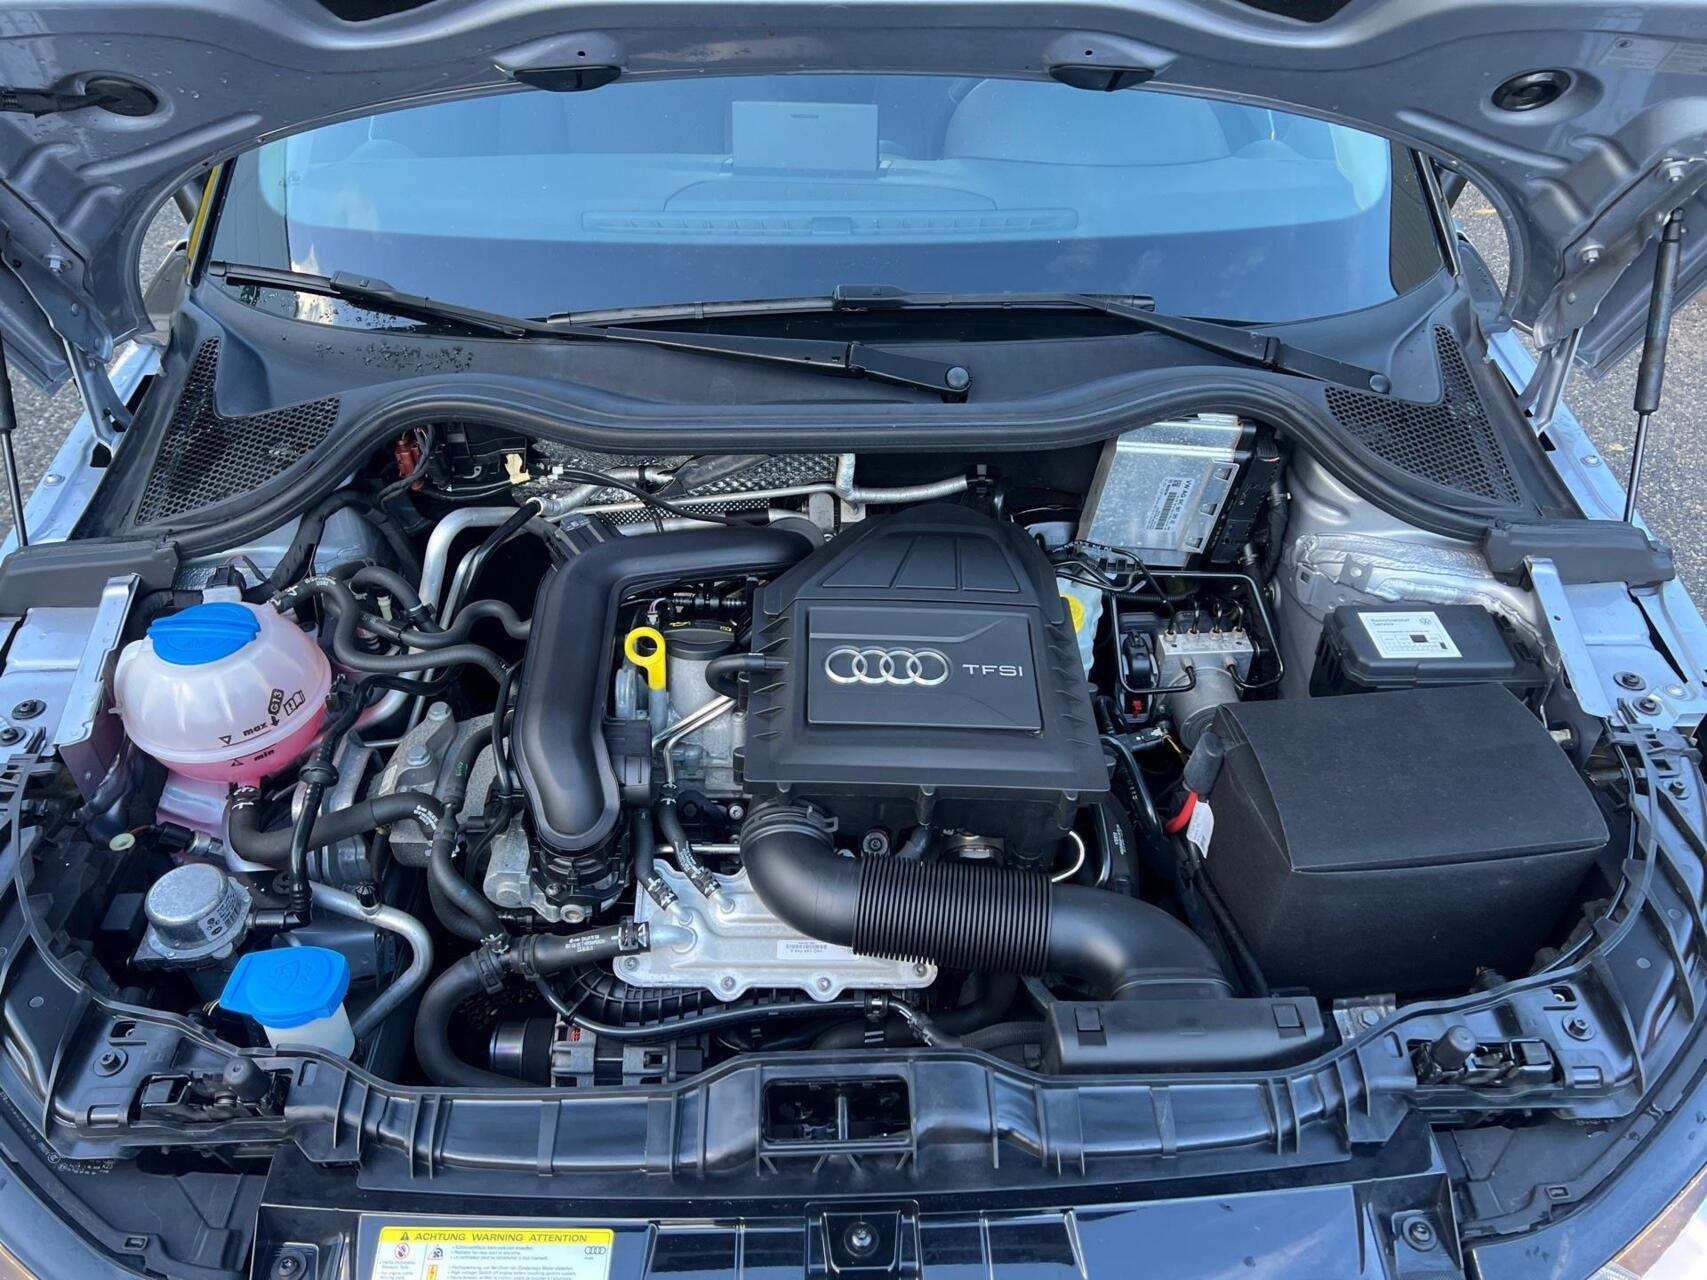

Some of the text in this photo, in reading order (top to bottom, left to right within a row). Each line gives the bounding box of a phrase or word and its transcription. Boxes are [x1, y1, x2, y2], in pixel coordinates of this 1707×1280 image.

[962, 663, 1023, 677] TFSI
[270, 690, 282, 712] G13
[243, 722, 268, 736] max
[254, 749, 275, 761] min
[414, 1232, 588, 1243] ACHTUNG WARNING ATTENTION
